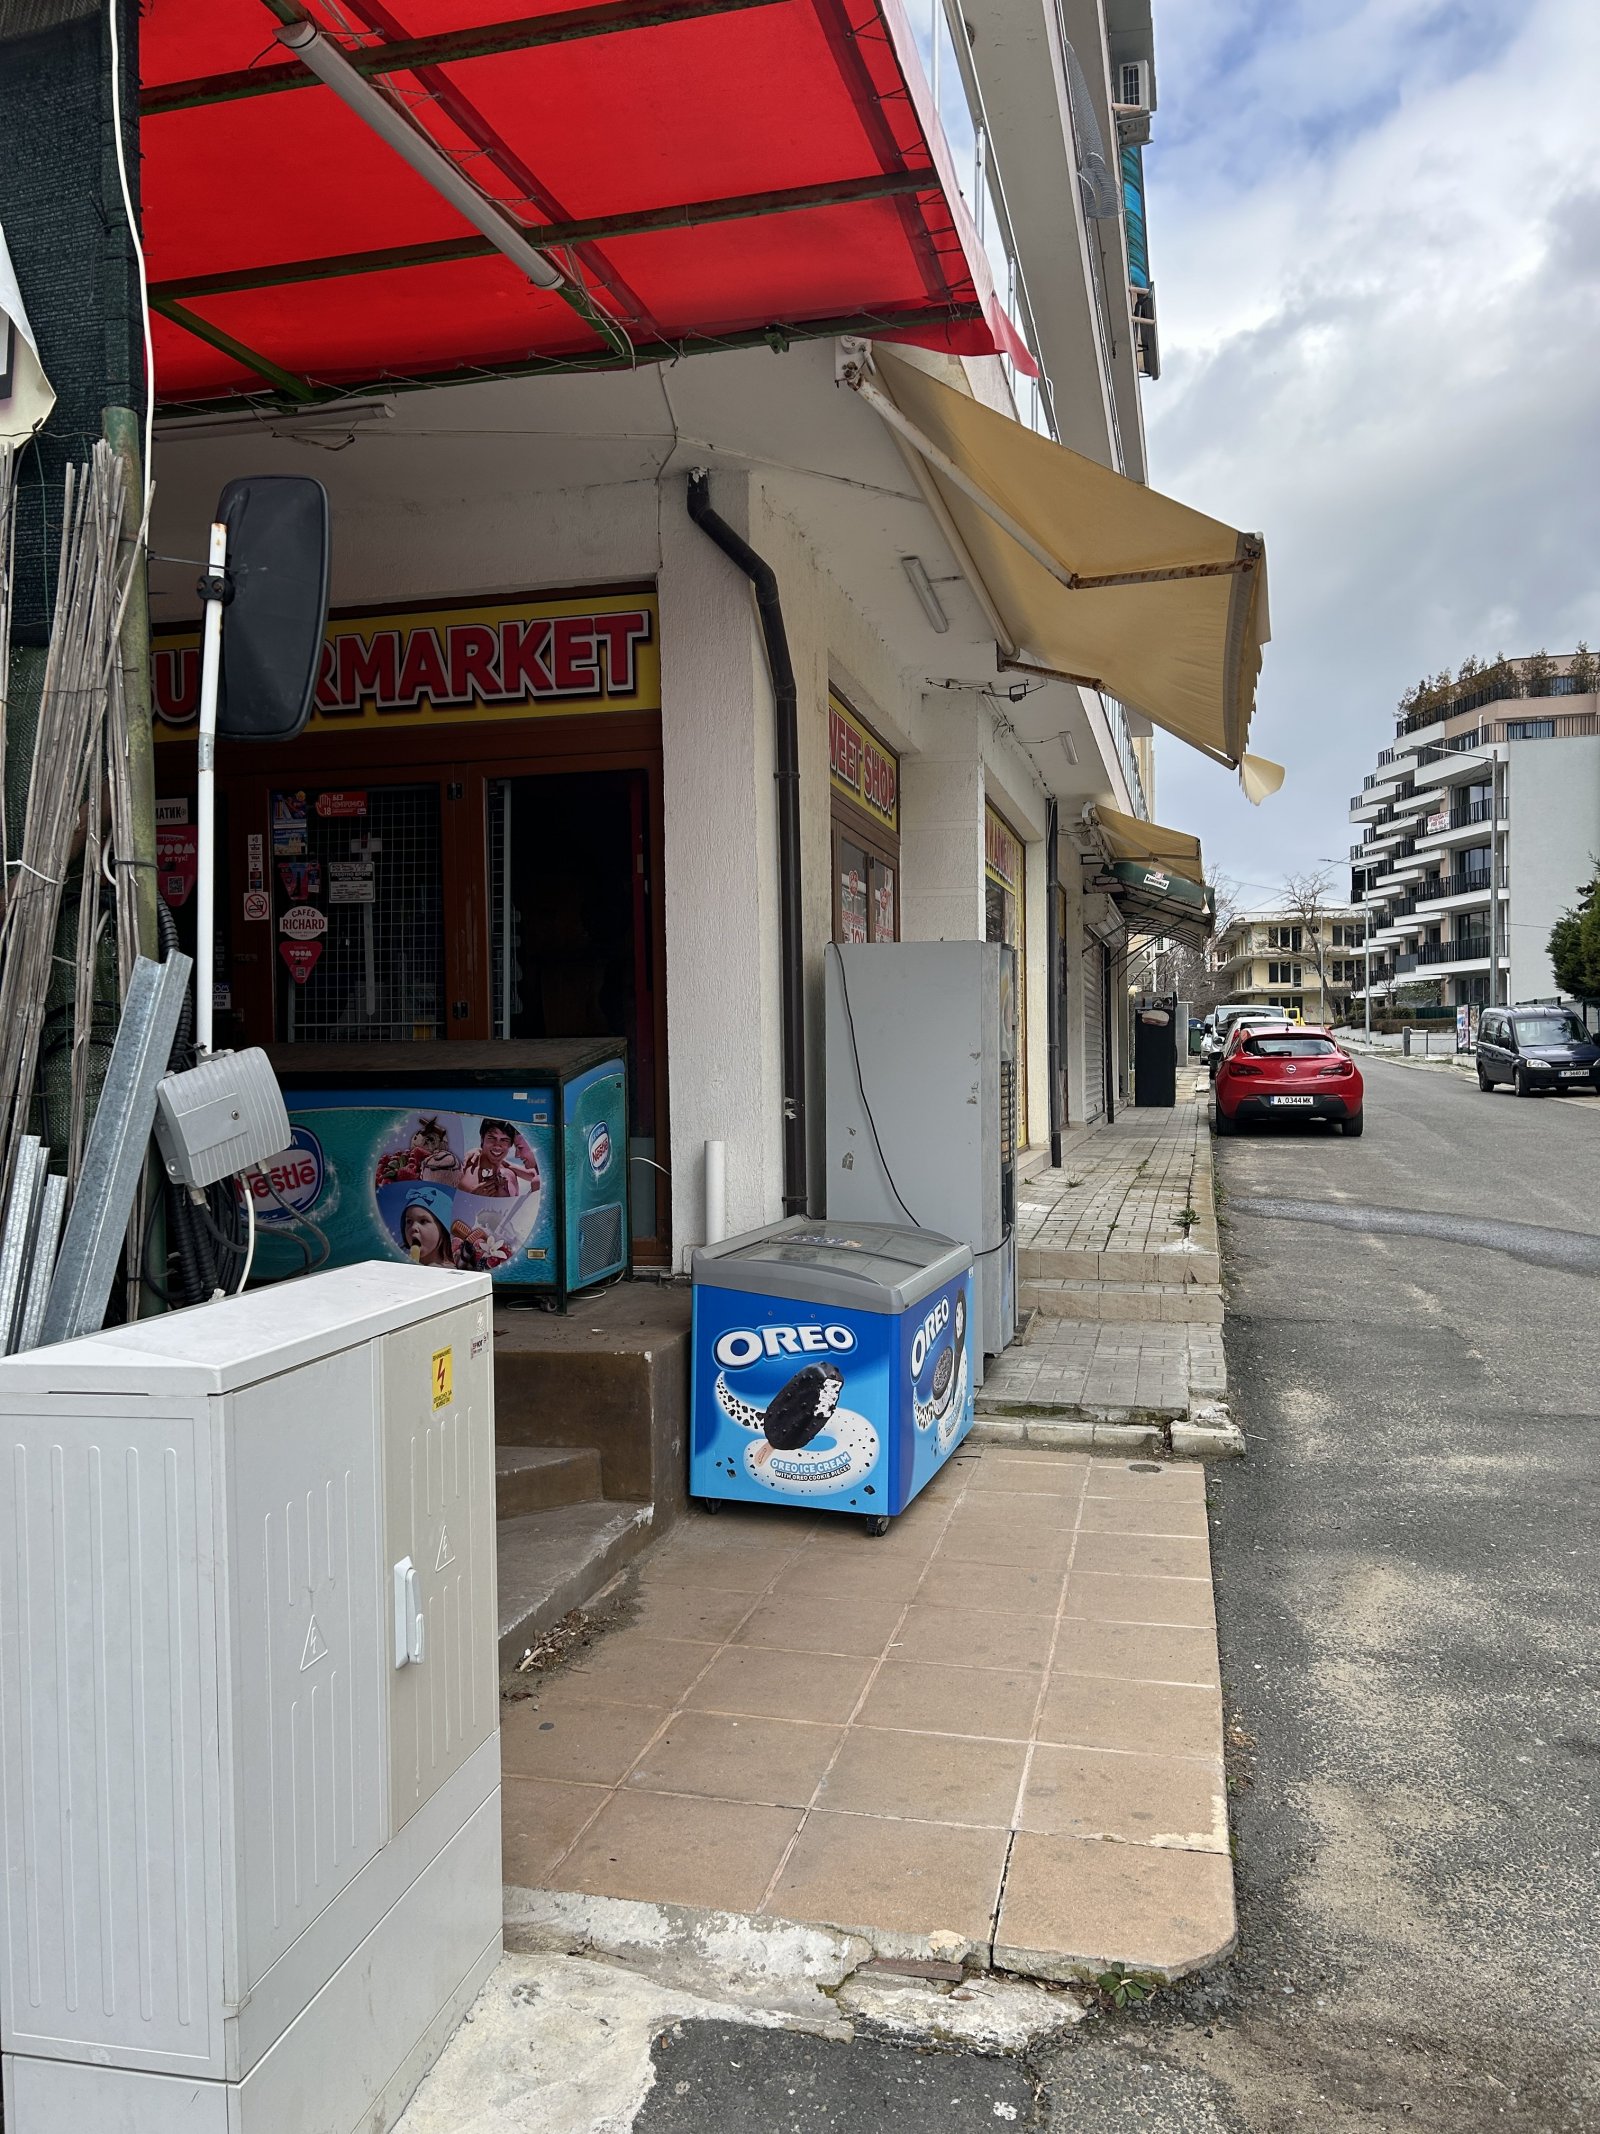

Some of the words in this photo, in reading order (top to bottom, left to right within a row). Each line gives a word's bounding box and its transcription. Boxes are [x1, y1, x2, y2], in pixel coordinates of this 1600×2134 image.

[151, 611, 650, 724] URMARKET
[828, 705, 862, 790] WEET
[864, 742, 895, 815] SHOP
[156, 806, 182, 820] АТИК
[323, 807, 332, 816] 18
[291, 908, 316, 918] CAFÉS
[282, 919, 325, 930] RICHARD
[289, 949, 313, 957] VOOM
[716, 1325, 853, 1366] OREO
[912, 1299, 949, 1378] OREO
[771, 1459, 798, 1473] OREO
[800, 1464, 816, 1474] ICE
[817, 1452, 850, 1472] CREAM
[775, 1470, 792, 1479] WITH
[808, 1473, 831, 1481] COOKIE
[831, 1464, 851, 1478] PIECES
